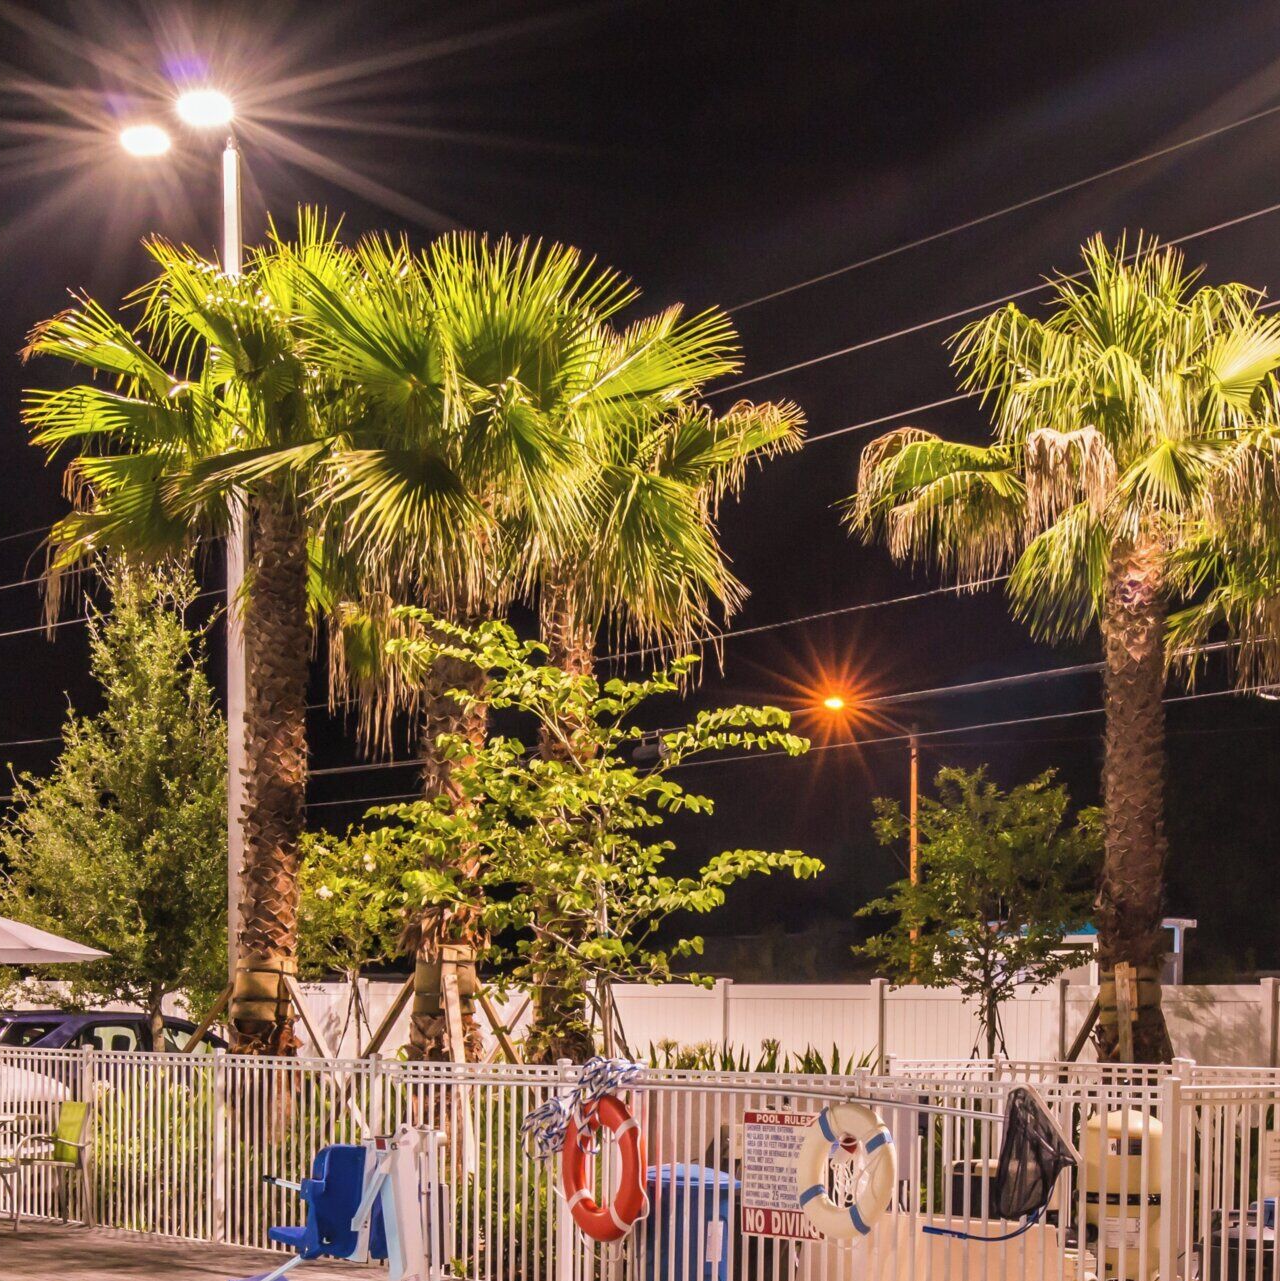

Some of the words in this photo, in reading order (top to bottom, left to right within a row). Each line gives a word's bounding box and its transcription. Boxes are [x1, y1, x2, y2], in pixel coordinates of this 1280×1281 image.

[756, 1113, 780, 1124] POOL
[784, 1115, 811, 1125] RULES
[745, 1208, 765, 1233] NO
